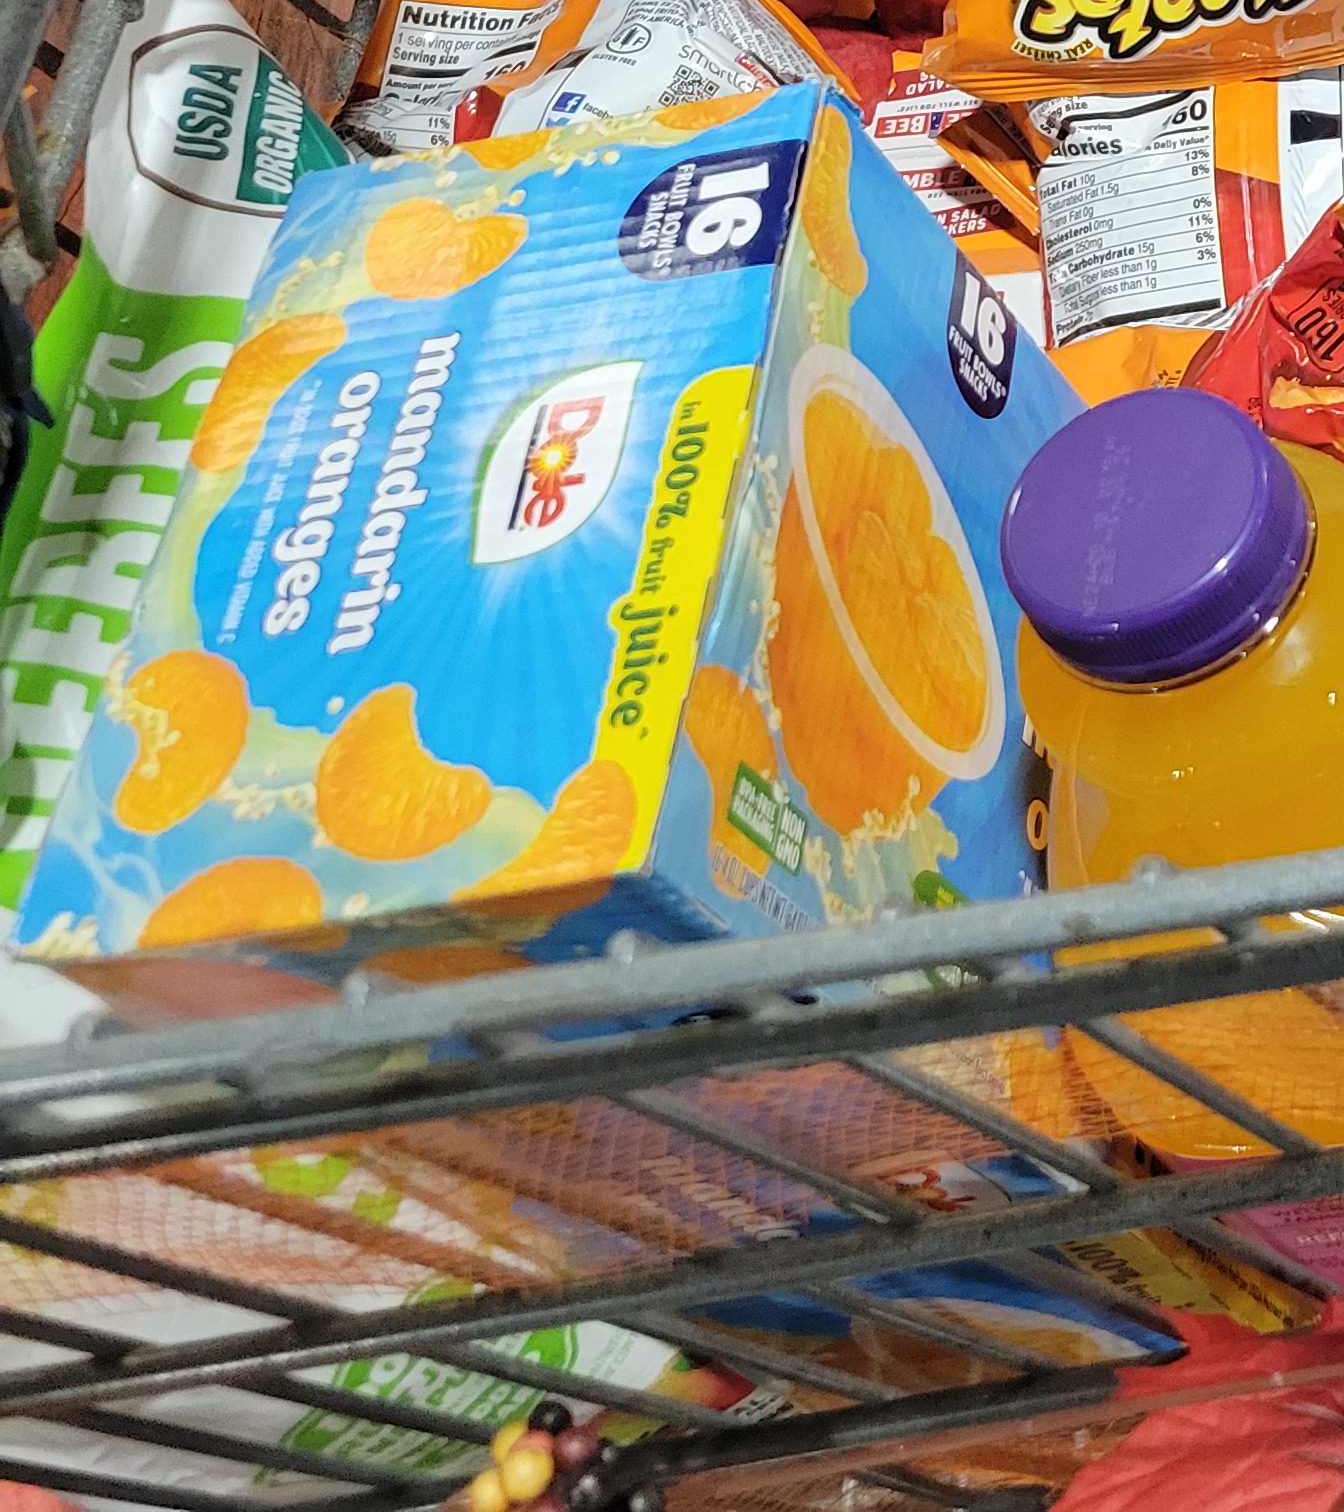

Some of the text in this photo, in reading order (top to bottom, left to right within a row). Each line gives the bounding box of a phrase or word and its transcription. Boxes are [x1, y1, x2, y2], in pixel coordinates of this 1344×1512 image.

[392, 47, 437, 66] Serving
[402, 5, 514, 31] Nutrition
[173, 64, 243, 162] USDA
[253, 71, 303, 194] ORGANIC
[428, 117, 451, 129] 11%
[430, 134, 450, 146] 6%
[883, 119, 926, 134] BEE
[653, 162, 696, 271] FRUIT BOWLS
[685, 161, 770, 256] 16
[1068, 245, 1135, 275] Carbohydrate
[949, 325, 1002, 399] FRUIT BOWLS
[961, 271, 1007, 366] 16
[263, 371, 381, 635] oranges
[328, 331, 462, 655] mandarin
[523, 395, 608, 529] Dole
[610, 420, 710, 728] 100% fruit juice
[776, 834, 801, 870] GMO
